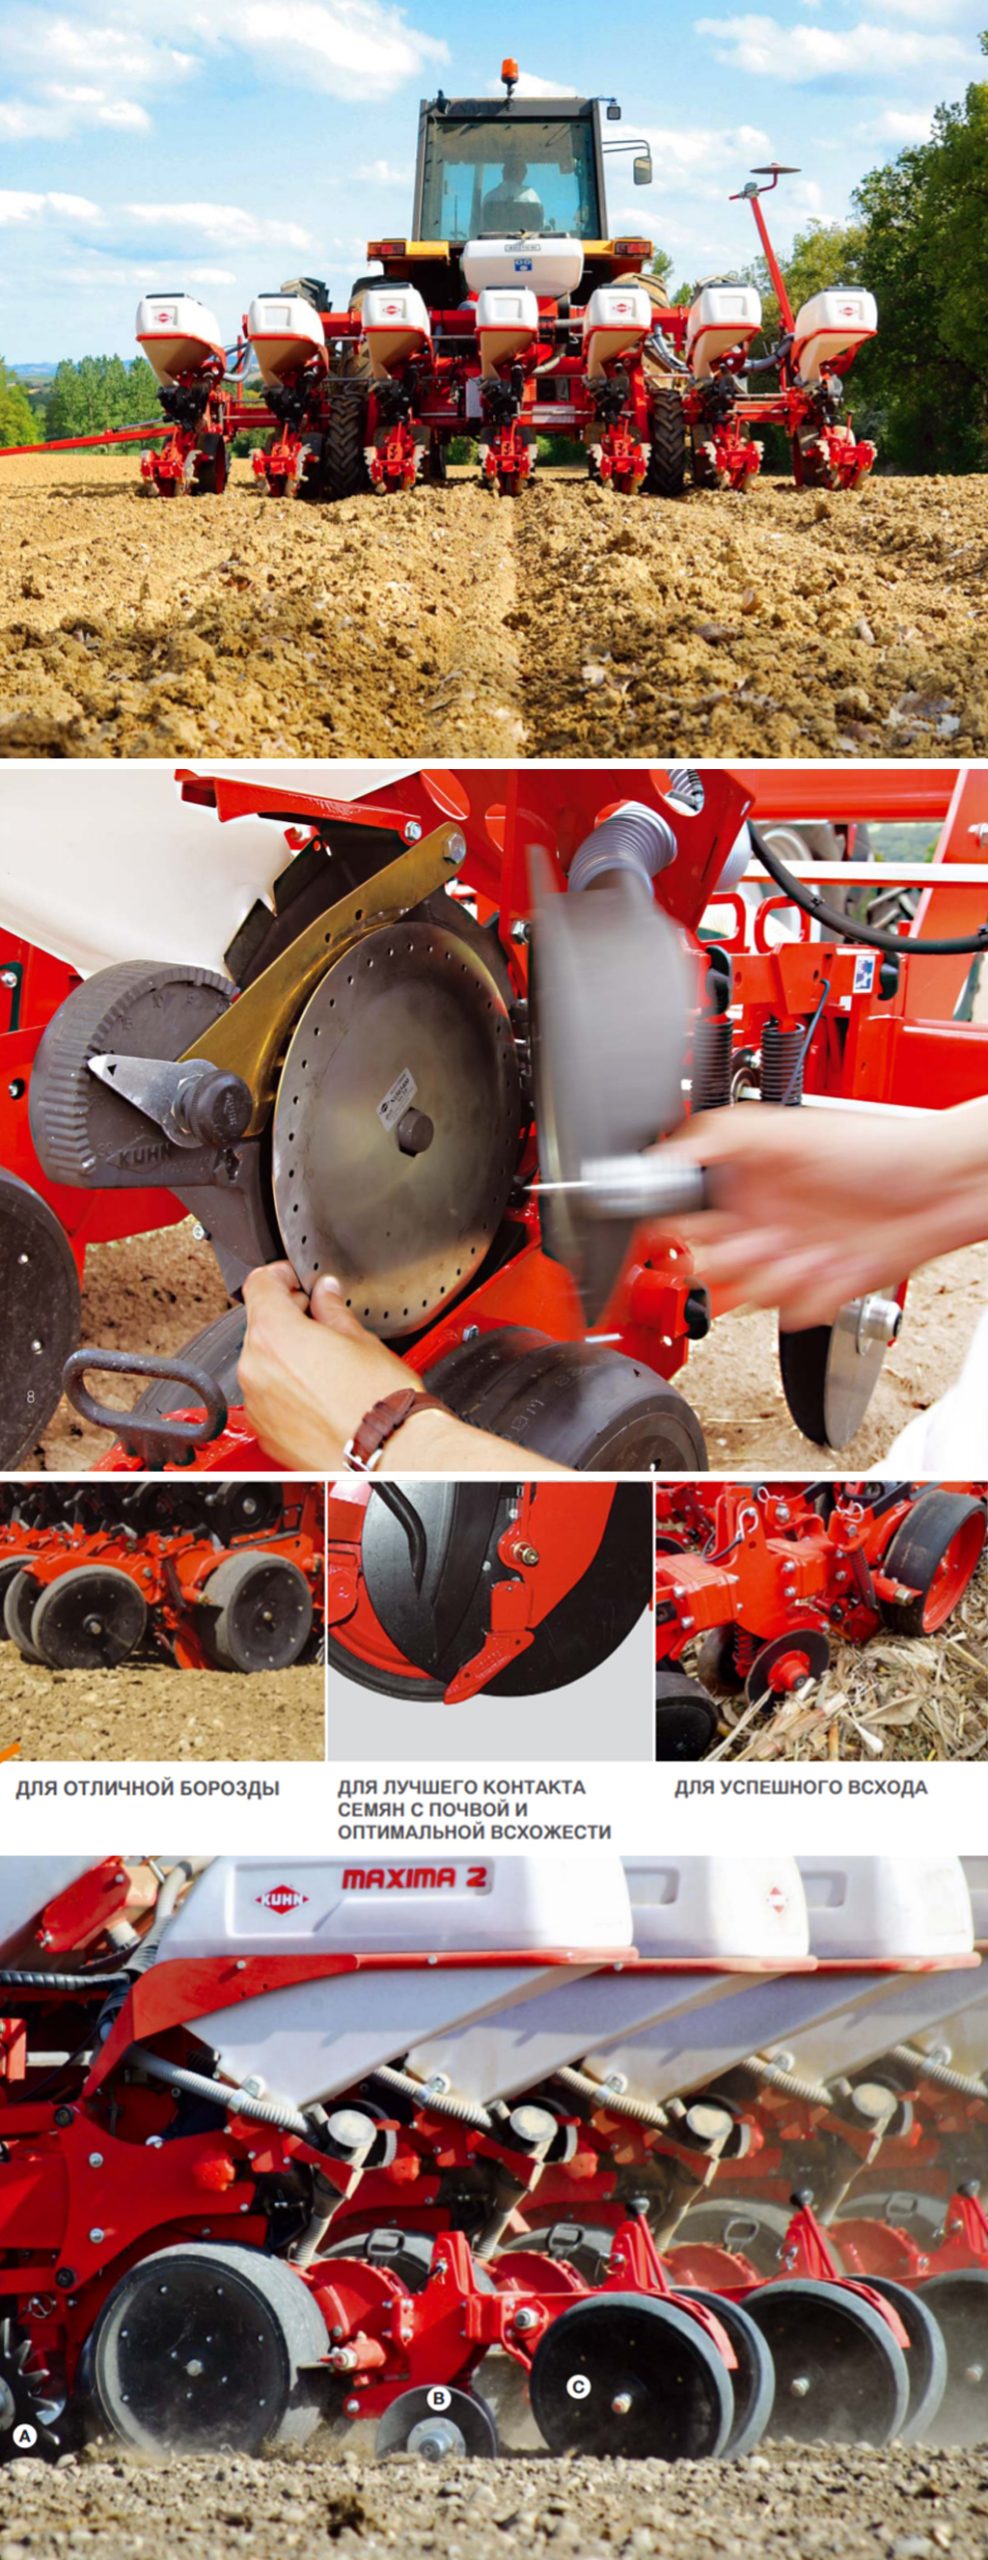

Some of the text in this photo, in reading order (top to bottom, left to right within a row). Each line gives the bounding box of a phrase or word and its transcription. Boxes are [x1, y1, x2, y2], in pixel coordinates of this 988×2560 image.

[118, 1143, 172, 1168] KUHN
[342, 1866, 487, 1890] MAXIMA 2
[261, 1893, 303, 1907] KUHN
